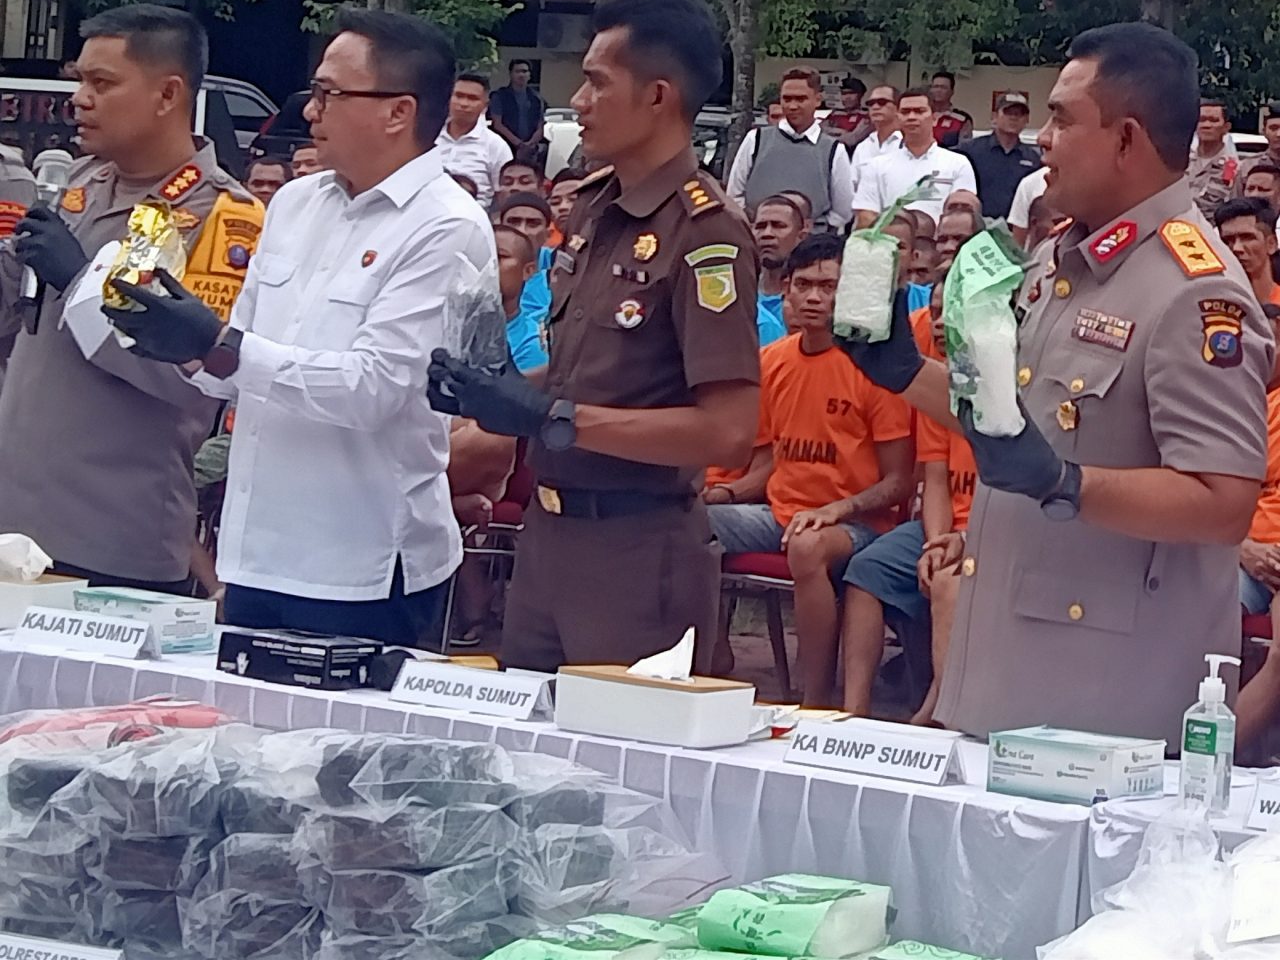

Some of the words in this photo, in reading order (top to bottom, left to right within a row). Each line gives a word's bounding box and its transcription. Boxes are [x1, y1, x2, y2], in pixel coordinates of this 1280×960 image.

[193, 280, 240, 297] KASAT
[1203, 301, 1243, 318] POLDA
[826, 398, 852, 417] 57
[21, 612, 83, 636] KAJATI
[83, 621, 145, 645] SUMUT
[403, 675, 475, 699] KAPOLDA
[476, 682, 532, 708] SUMUT
[792, 733, 818, 753] KA
[822, 737, 875, 760] BNNP
[878, 746, 946, 772] SUMUT
